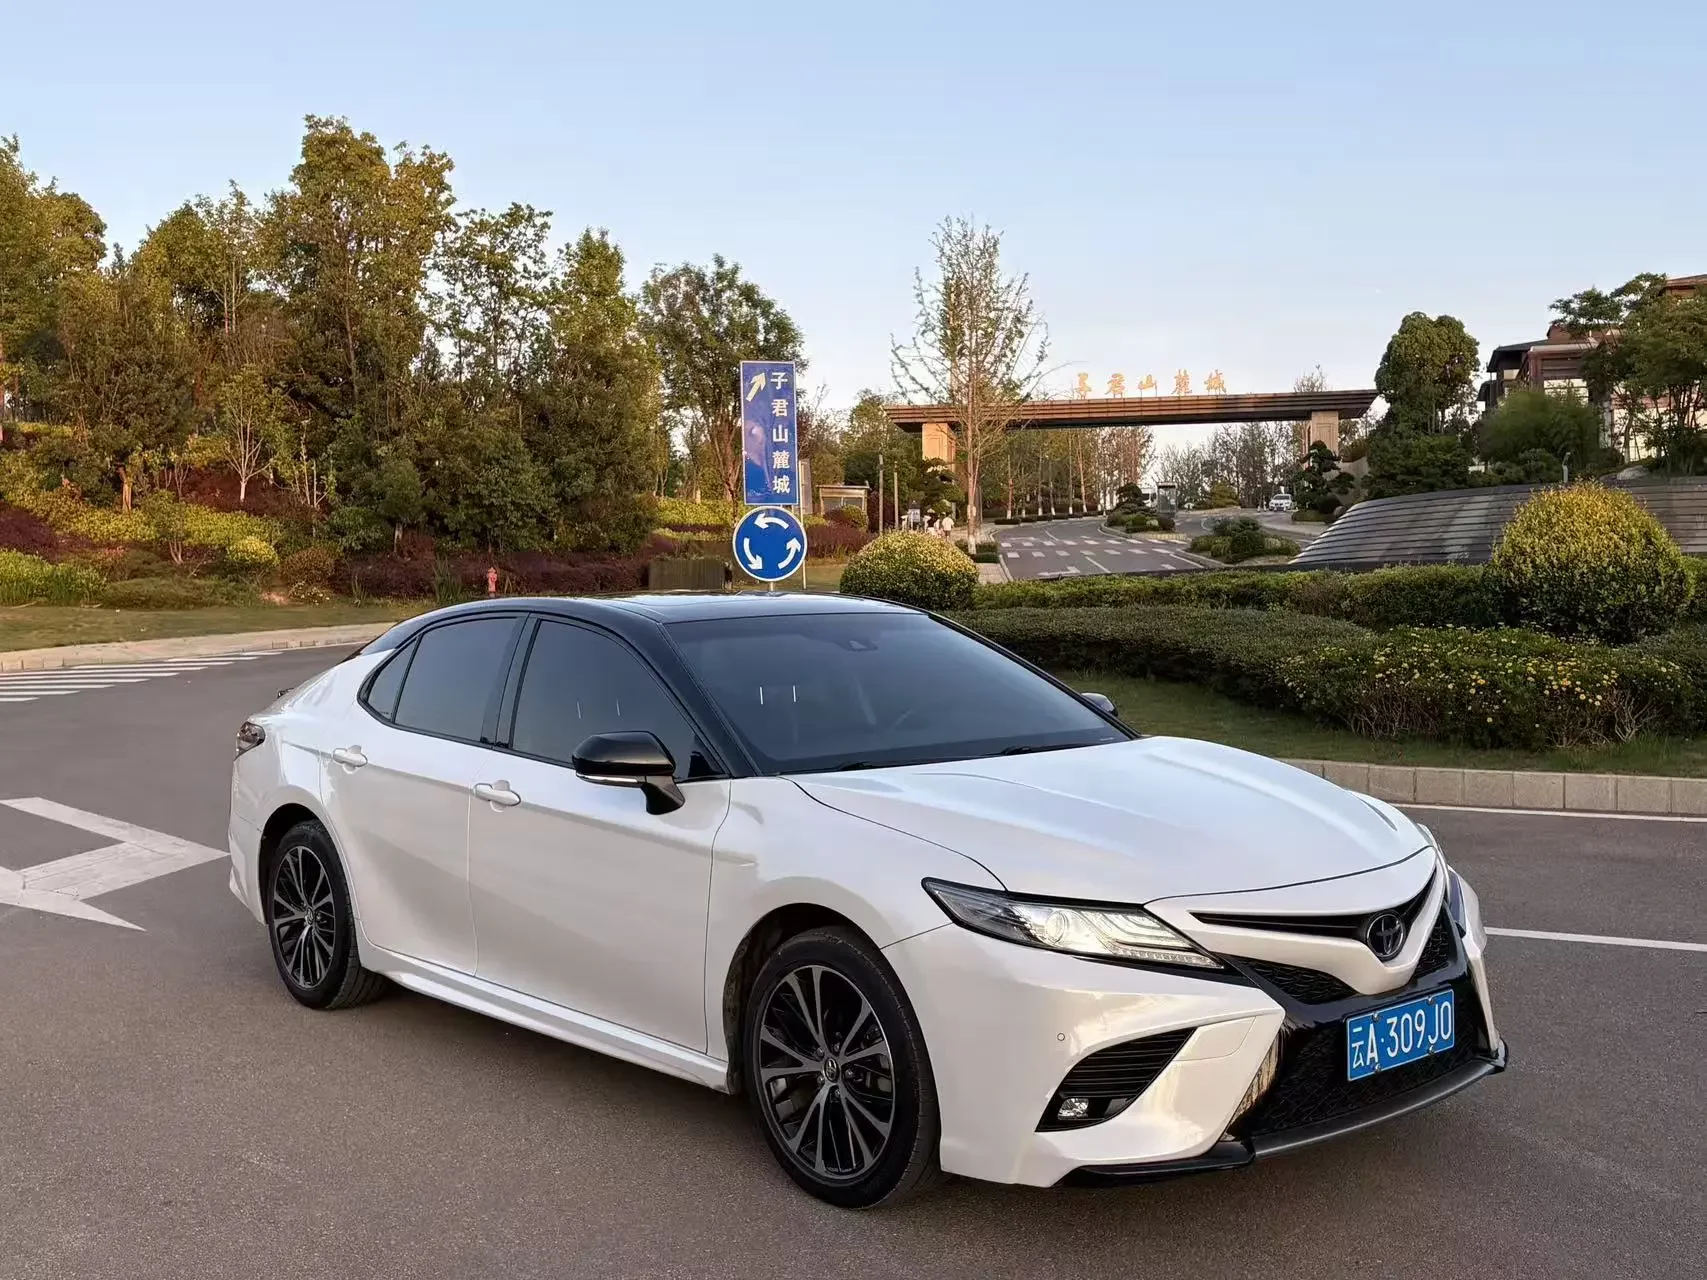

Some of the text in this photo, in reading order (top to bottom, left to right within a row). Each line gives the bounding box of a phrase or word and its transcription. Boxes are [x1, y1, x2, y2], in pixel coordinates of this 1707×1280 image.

[770, 371, 791, 494] 子君山麓城
